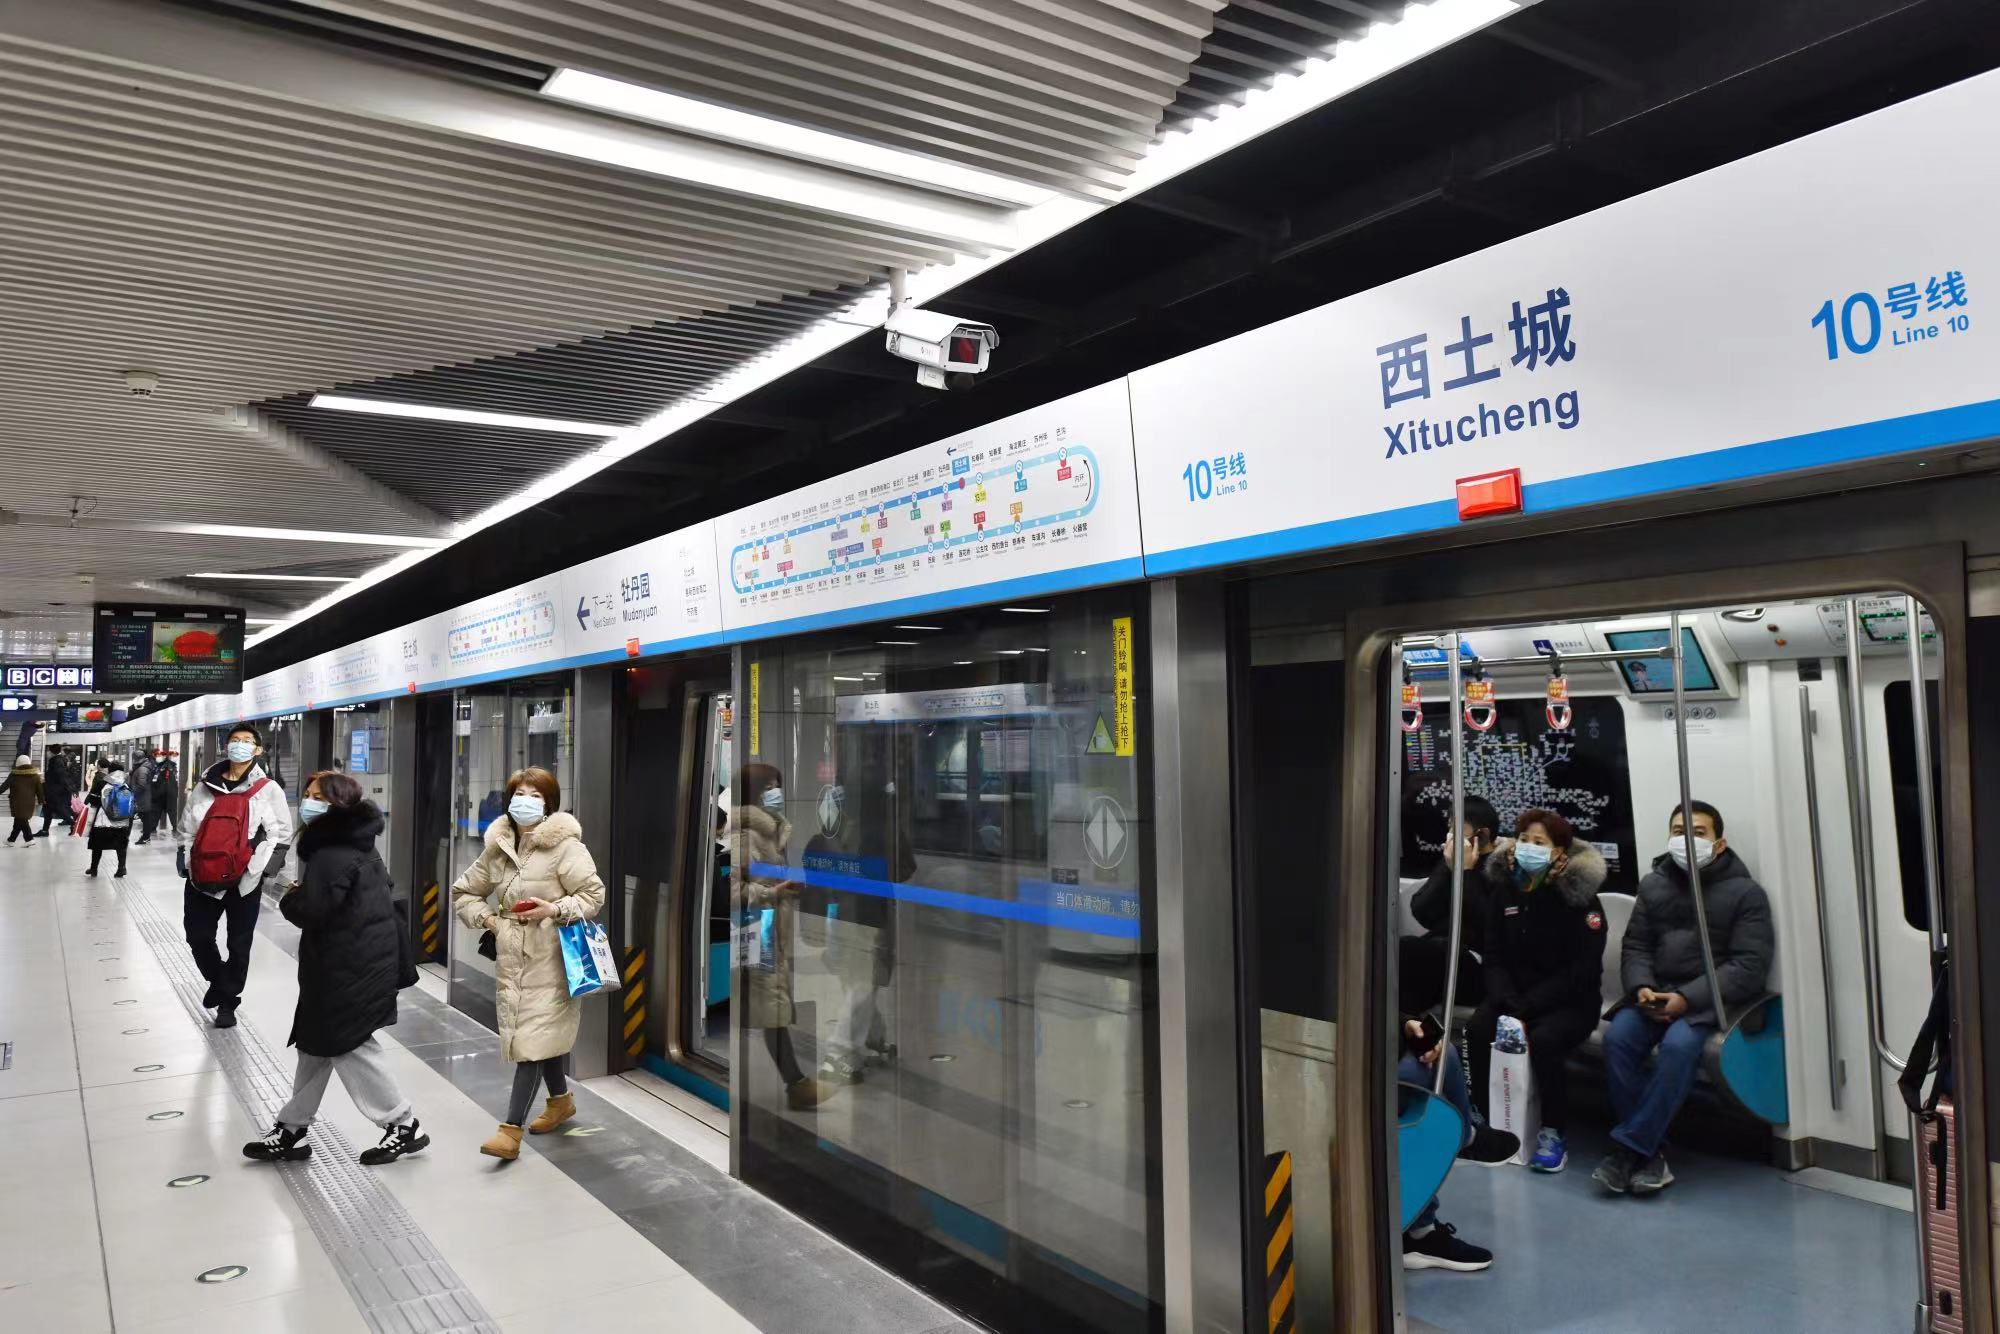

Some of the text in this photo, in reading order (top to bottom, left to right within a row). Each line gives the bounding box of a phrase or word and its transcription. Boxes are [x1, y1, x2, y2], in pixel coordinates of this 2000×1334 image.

[1892, 315, 1969, 346] Line 10
[1376, 286, 1577, 409] 西土城
[1383, 390, 1580, 459] Xitucheng
[1216, 479, 1248, 496] Line 10
[621, 573, 650, 603] 牡丹园
[622, 606, 658, 622] Mudanyuan
[12, 670, 51, 684] B C
[1118, 626, 1128, 749] 关门铃响 请勿抢上抢下
